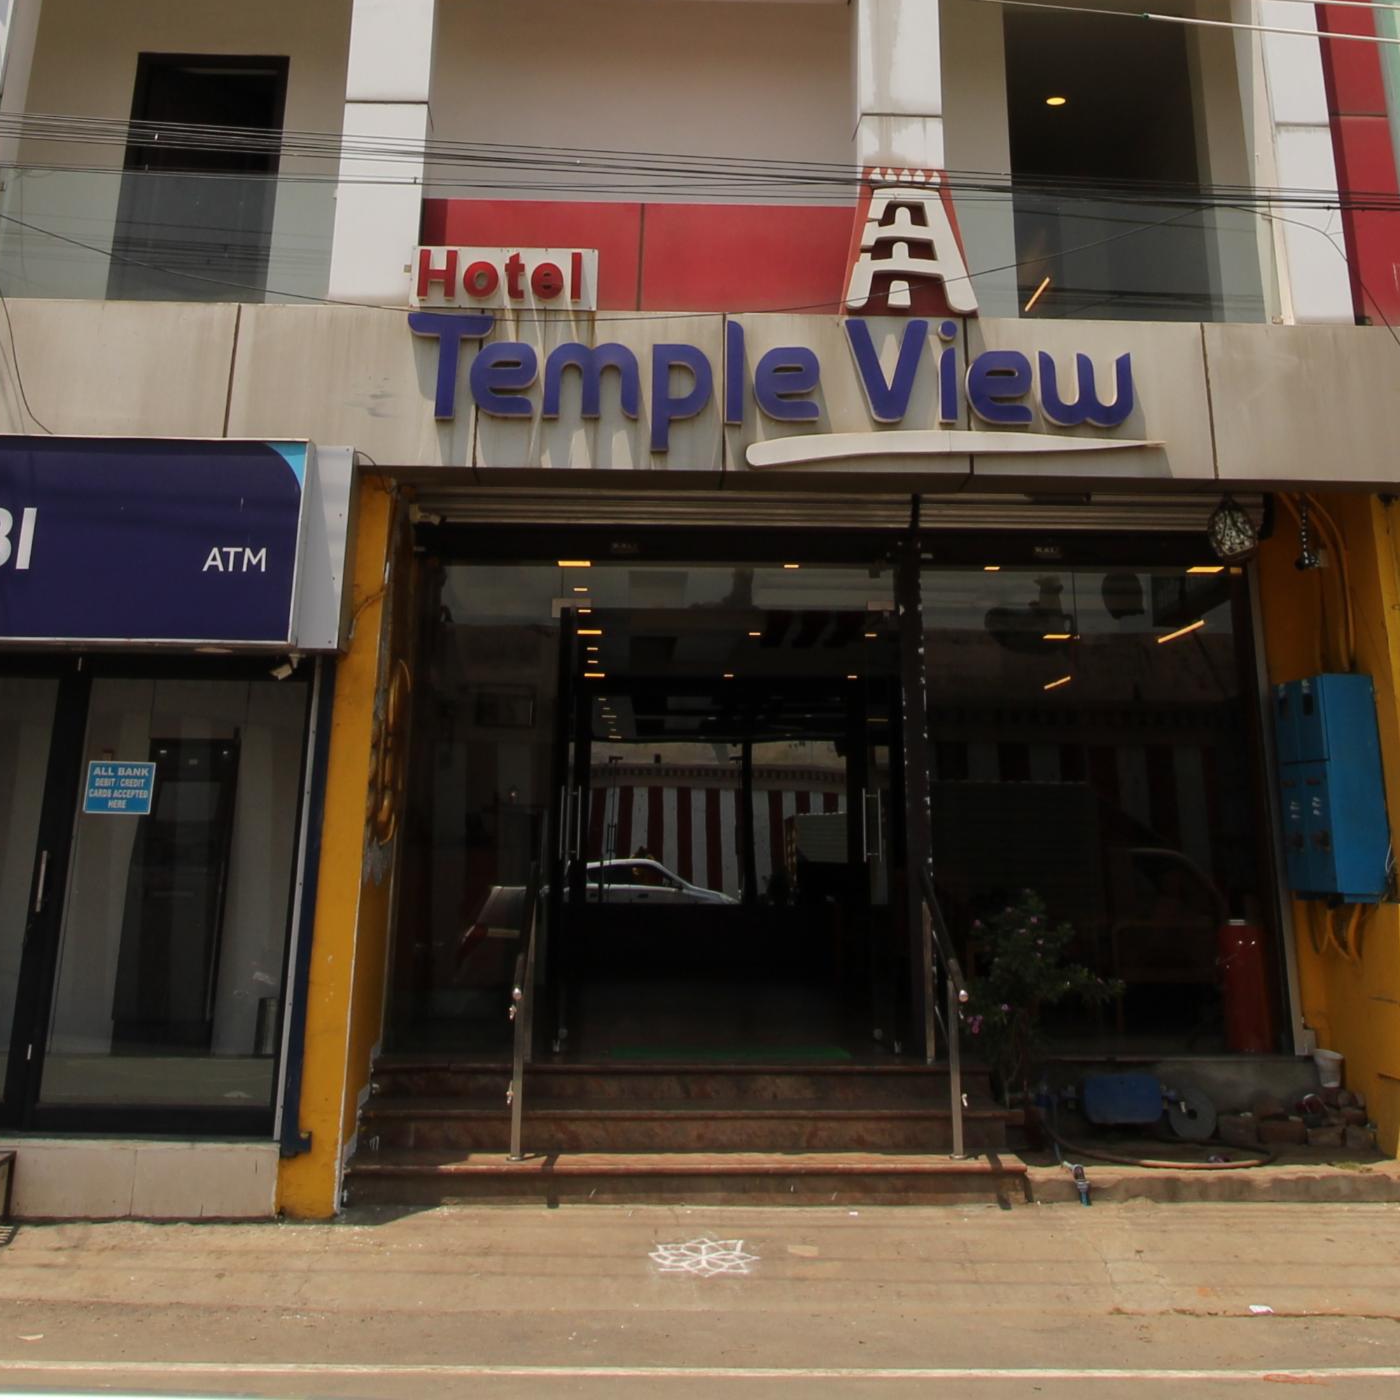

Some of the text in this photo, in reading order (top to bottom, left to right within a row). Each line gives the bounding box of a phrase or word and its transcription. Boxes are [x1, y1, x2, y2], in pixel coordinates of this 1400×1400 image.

[415, 248, 583, 302] Hotel
[406, 311, 1135, 453] Temple View
[202, 547, 267, 573] ATM
[93, 766, 150, 777] ALL BANK
[95, 777, 116, 787] DEBIT
[120, 778, 145, 788] CREDIT
[88, 788, 149, 798] CARDS ACCEPTED
[107, 799, 128, 809] HERE
